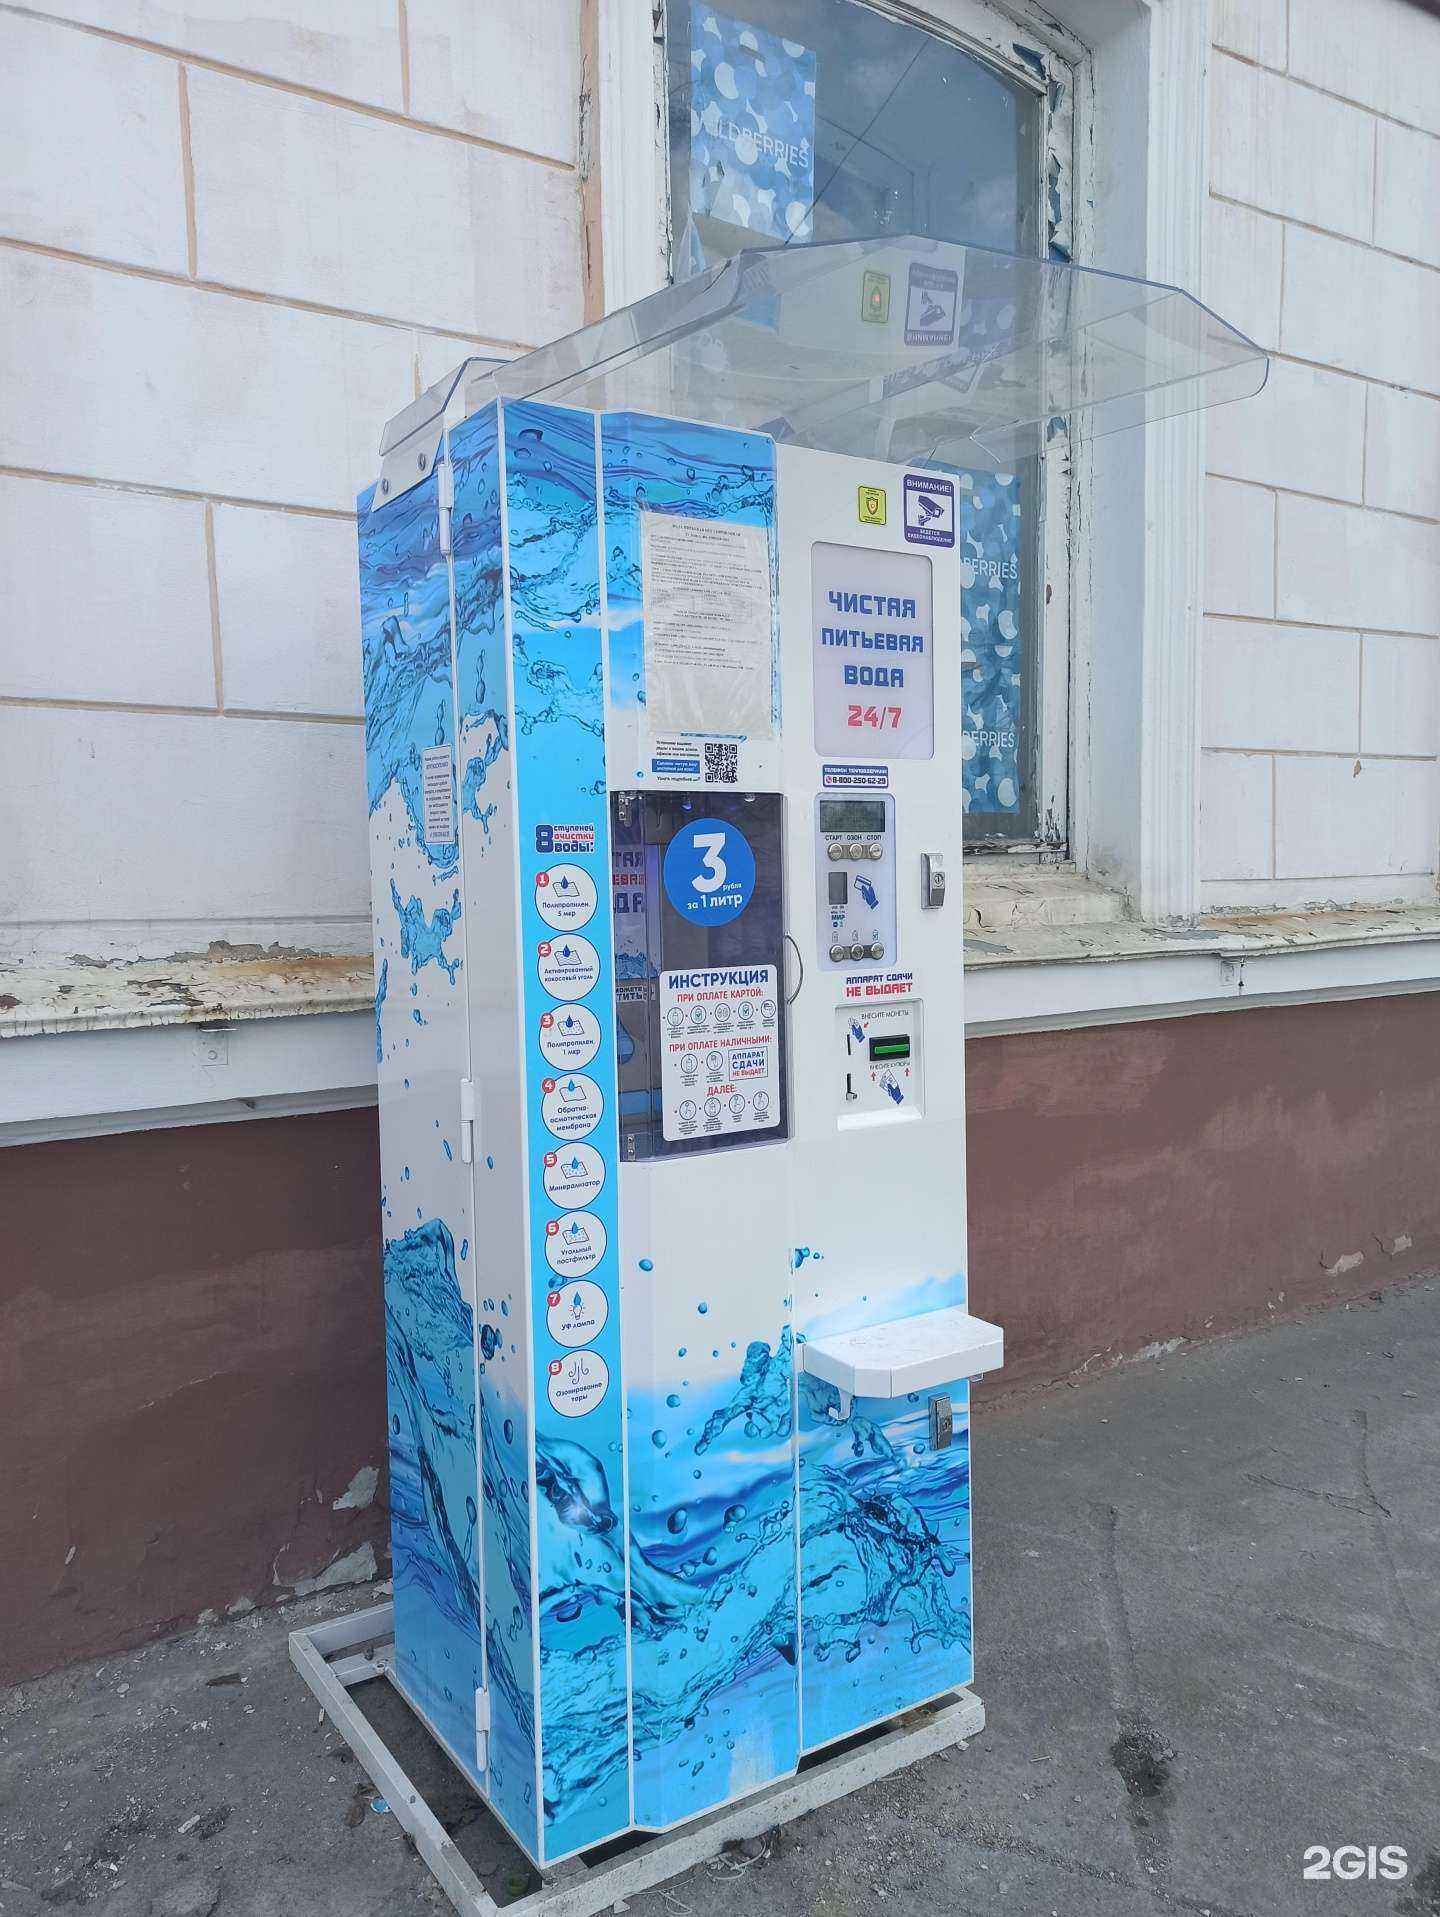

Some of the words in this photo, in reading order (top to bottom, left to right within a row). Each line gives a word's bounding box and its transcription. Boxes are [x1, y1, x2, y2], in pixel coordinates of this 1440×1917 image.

[718, 118, 809, 168] LDERRIES
[906, 479, 952, 493] ВНИМАНИЕ!
[829, 590, 916, 619] ЧИСТАЯ
[821, 627, 924, 653] ПИТЬЕВАЯ
[844, 664, 904, 688] ВОДА
[847, 704, 902, 730] 24/7
[553, 823, 594, 833] ступеней
[536, 824, 554, 853] 8
[554, 840, 594, 853] воды:
[692, 832, 727, 893] 3
[722, 882, 742, 892] рубля
[614, 892, 645, 913] ДА
[687, 902, 699, 910] за
[700, 894, 707, 908] 1
[710, 894, 743, 908] литр
[577, 974, 593, 982] уголь
[668, 969, 769, 989] ИНСТРУКЦИЯ
[846, 974, 884, 985] АППАРАТ
[886, 972, 913, 982] СДАЧИ
[677, 993, 695, 1003] ПРИ
[696, 990, 728, 1001] ОПЛАТЕ
[730, 986, 764, 999] КАРТОЙ:
[846, 986, 862, 997] НЕ
[865, 982, 913, 996] ВЫДАЕТ
[669, 1043, 686, 1053] ПРИ
[687, 1039, 718, 1051] ОПЛАТЕ
[731, 1050, 765, 1060] АППАРАТ
[731, 1058, 765, 1070] СДАЧИ
[556, 1122, 591, 1131] мембрана
[548, 1180, 601, 1192] Минерализатор
[561, 1245, 592, 1255] Угольный
[556, 1253, 596, 1265] постфильтр
[572, 1319, 595, 1329] лампа
[570, 1394, 588, 1402] тары
